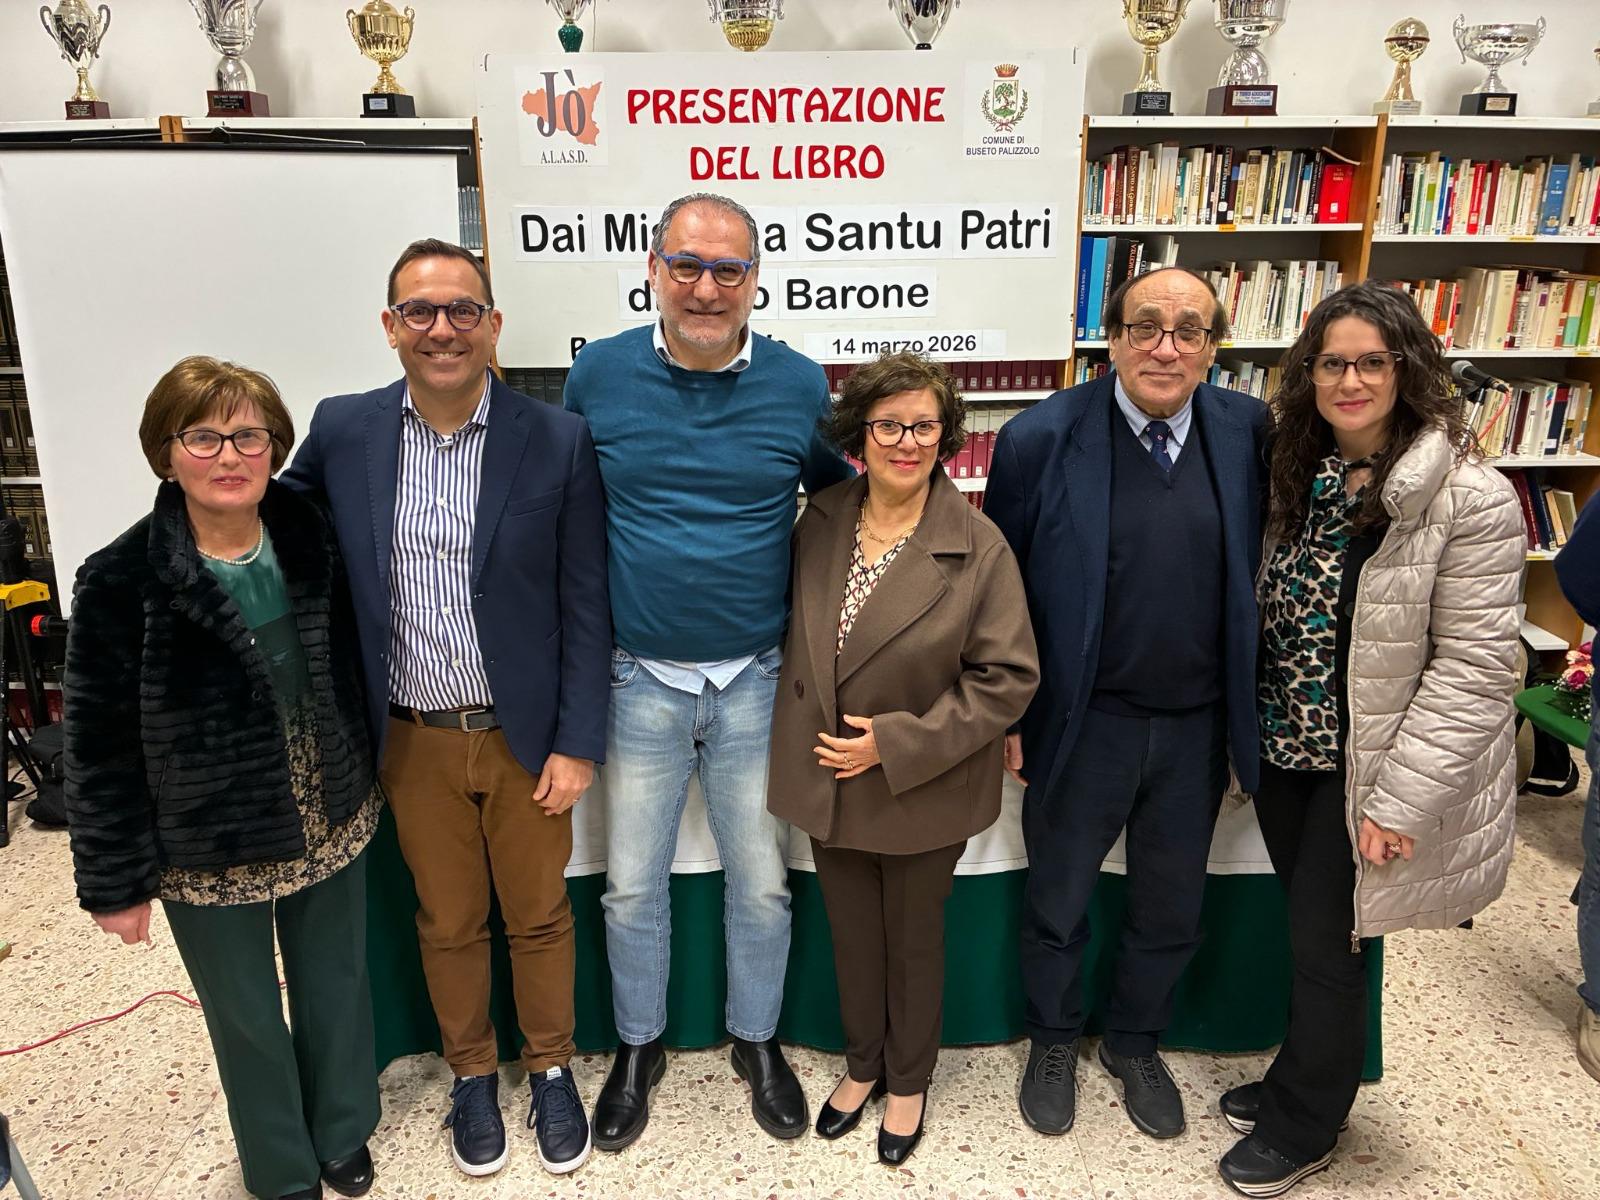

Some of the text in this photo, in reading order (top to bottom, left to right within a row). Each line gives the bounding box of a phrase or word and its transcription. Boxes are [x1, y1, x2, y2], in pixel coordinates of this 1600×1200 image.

[537, 69, 586, 137] Jò
[627, 86, 945, 125] PRESENTAZIONE
[540, 149, 588, 164] A.L.A.S.D.
[966, 146, 1040, 156] BUSETO PALIZZOLO
[982, 136, 1025, 145] COMUNE DI
[689, 144, 885, 181] DEL LIBRO
[520, 213, 586, 253] Dai
[805, 211, 941, 252] Santu
[961, 208, 1051, 251] Patri
[786, 278, 929, 311] Barone
[832, 334, 977, 355] 14 marzo 2026
